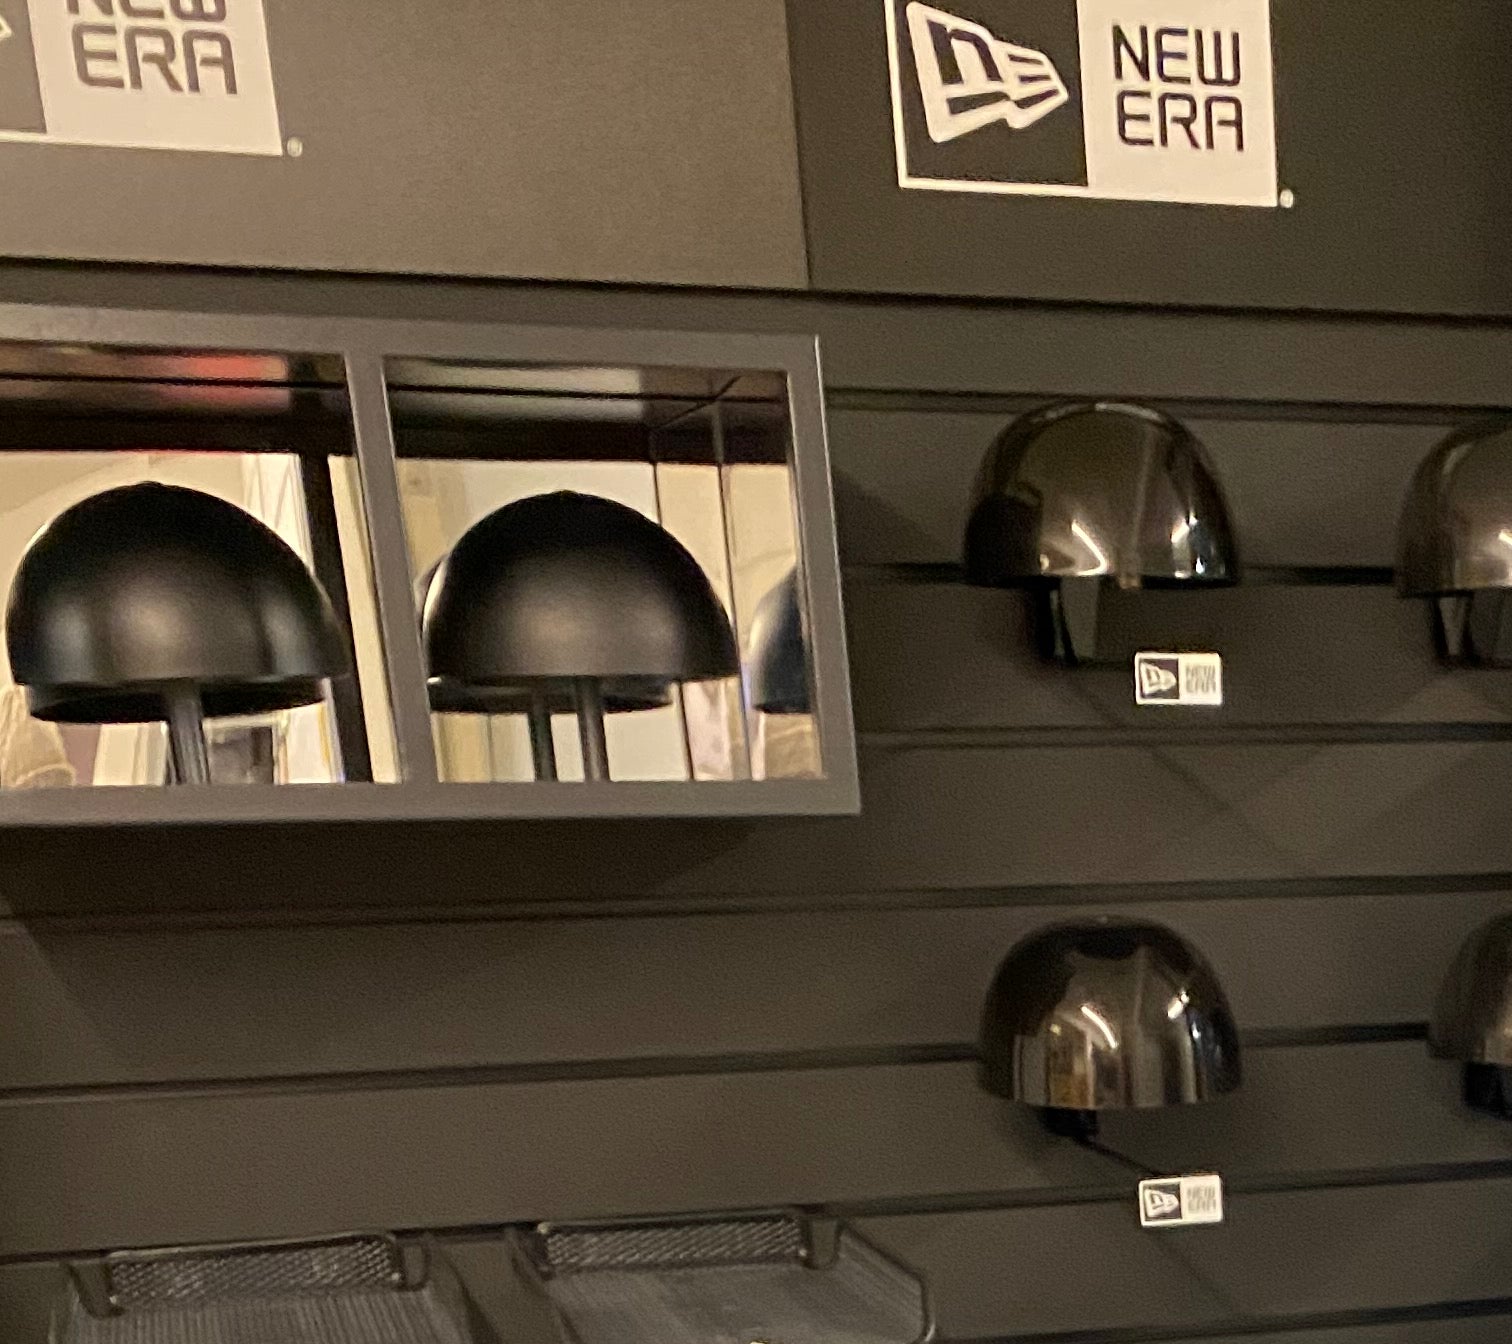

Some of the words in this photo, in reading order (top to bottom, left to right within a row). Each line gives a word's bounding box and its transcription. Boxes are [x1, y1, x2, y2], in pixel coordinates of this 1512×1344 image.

[72, 22, 238, 95] ERA
[1112, 25, 1241, 86] NEW
[1117, 90, 1244, 151] ERA
